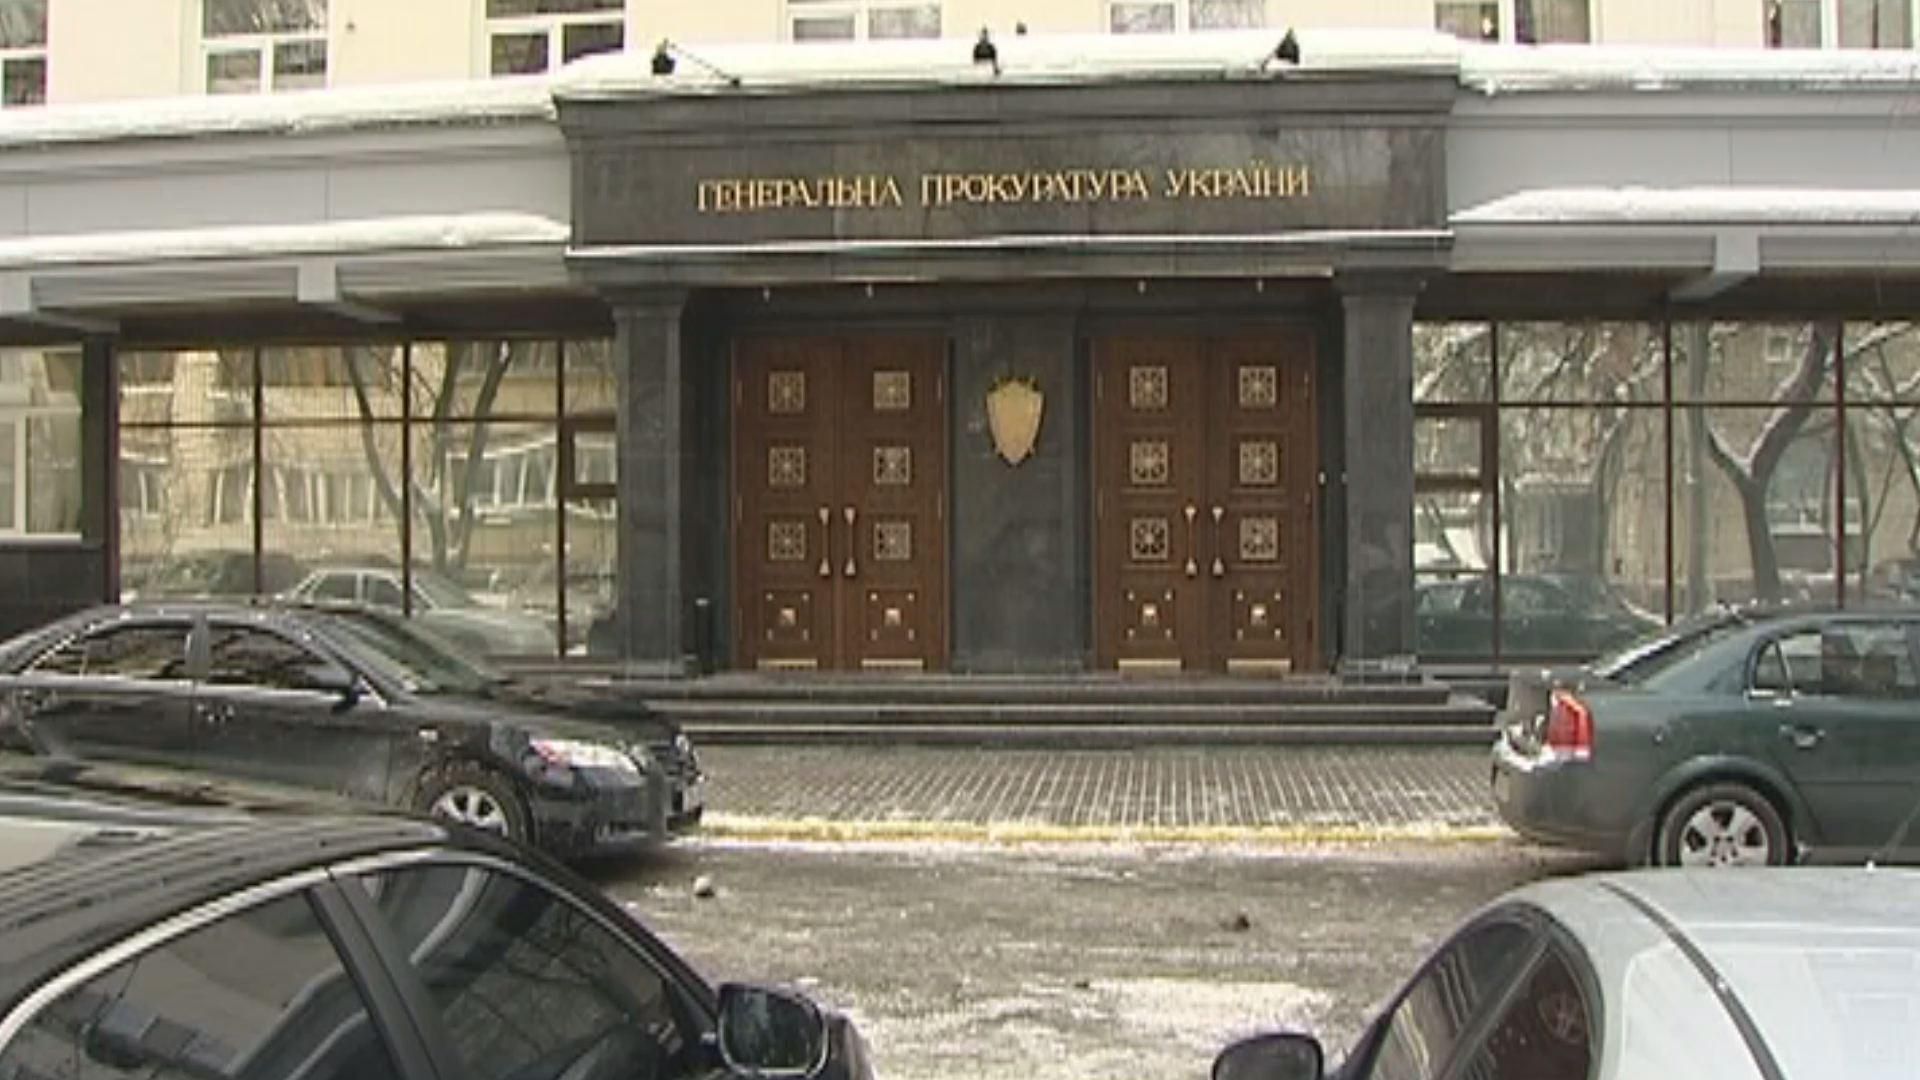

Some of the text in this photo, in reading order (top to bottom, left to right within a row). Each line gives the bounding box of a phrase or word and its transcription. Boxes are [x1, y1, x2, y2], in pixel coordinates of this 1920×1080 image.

[697, 160, 1310, 212] ГЕНЕРАЛЬНА ПРОКУРАТУРА УКРАЇНИ
